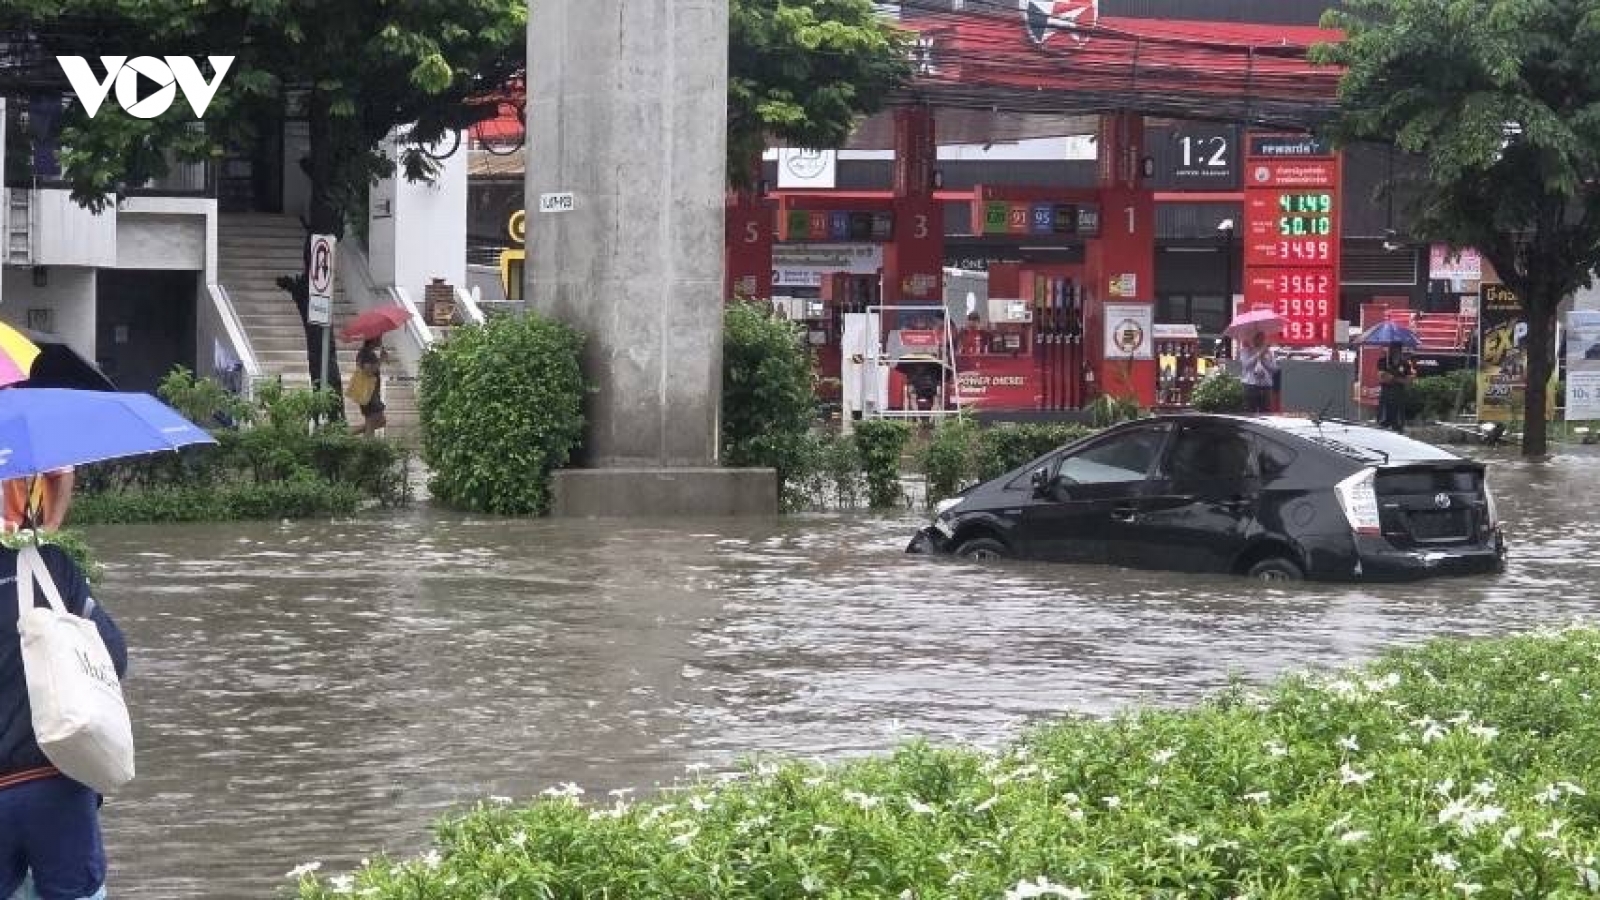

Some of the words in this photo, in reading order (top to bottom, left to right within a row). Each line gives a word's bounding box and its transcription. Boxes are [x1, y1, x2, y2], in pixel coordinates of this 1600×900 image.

[1180, 137, 1227, 166] 1:2
[1261, 142, 1310, 155] rewards
[1280, 195, 1331, 213] 41.49
[913, 216, 928, 239] 3
[1035, 212, 1049, 225] 95
[1124, 207, 1134, 234] 1
[1280, 218, 1330, 236] 50.10
[745, 222, 758, 243] 5
[1280, 242, 1329, 260] 34.99
[1280, 276, 1329, 294] 39.62
[1280, 300, 1329, 317] 39.99
